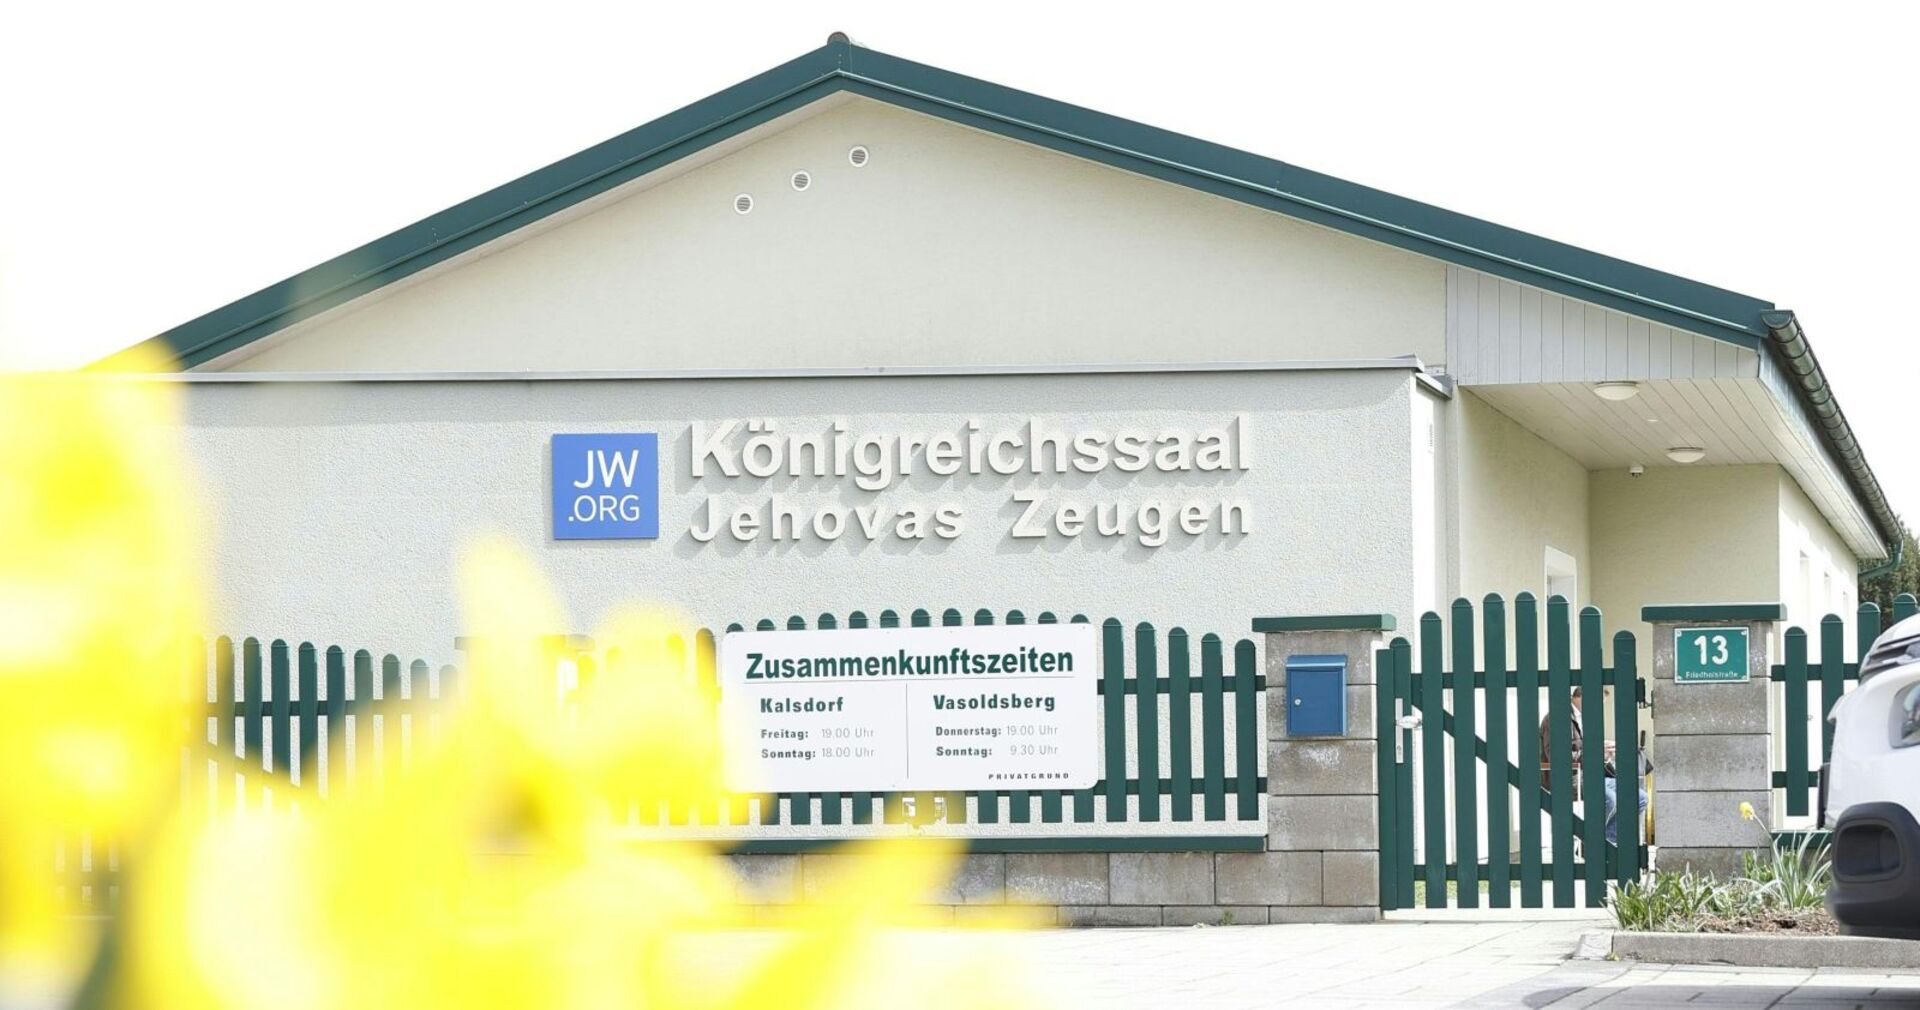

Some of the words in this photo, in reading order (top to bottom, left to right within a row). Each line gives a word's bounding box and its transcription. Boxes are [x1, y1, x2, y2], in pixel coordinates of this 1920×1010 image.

[691, 415, 1250, 491] Königreichssaal
[573, 450, 639, 489] JW
[568, 496, 640, 523] .ORG
[690, 496, 964, 543] Jehovas
[1011, 491, 1250, 547] Zeugen
[1694, 635, 1728, 665] 13
[745, 646, 1074, 680] Zusammenkunftszeiten
[760, 696, 844, 714] Kalsdorf
[933, 693, 1056, 712] Vasoldsberg
[760, 727, 809, 741] Freitag:
[821, 727, 851, 739] 19.00
[854, 726, 875, 738] Uhr
[935, 725, 1002, 738] Donnerstag:
[1006, 724, 1035, 736] 19.00
[1038, 724, 1058, 736] Uhr
[761, 748, 816, 761] Sonntag:
[821, 747, 851, 758] 18.00
[854, 746, 875, 758] Uhr
[935, 745, 993, 758] Sonntag:
[1010, 745, 1035, 756] 9.30
[1038, 744, 1059, 756] Uhr
[987, 772, 1071, 780] PRIVATGRUND
